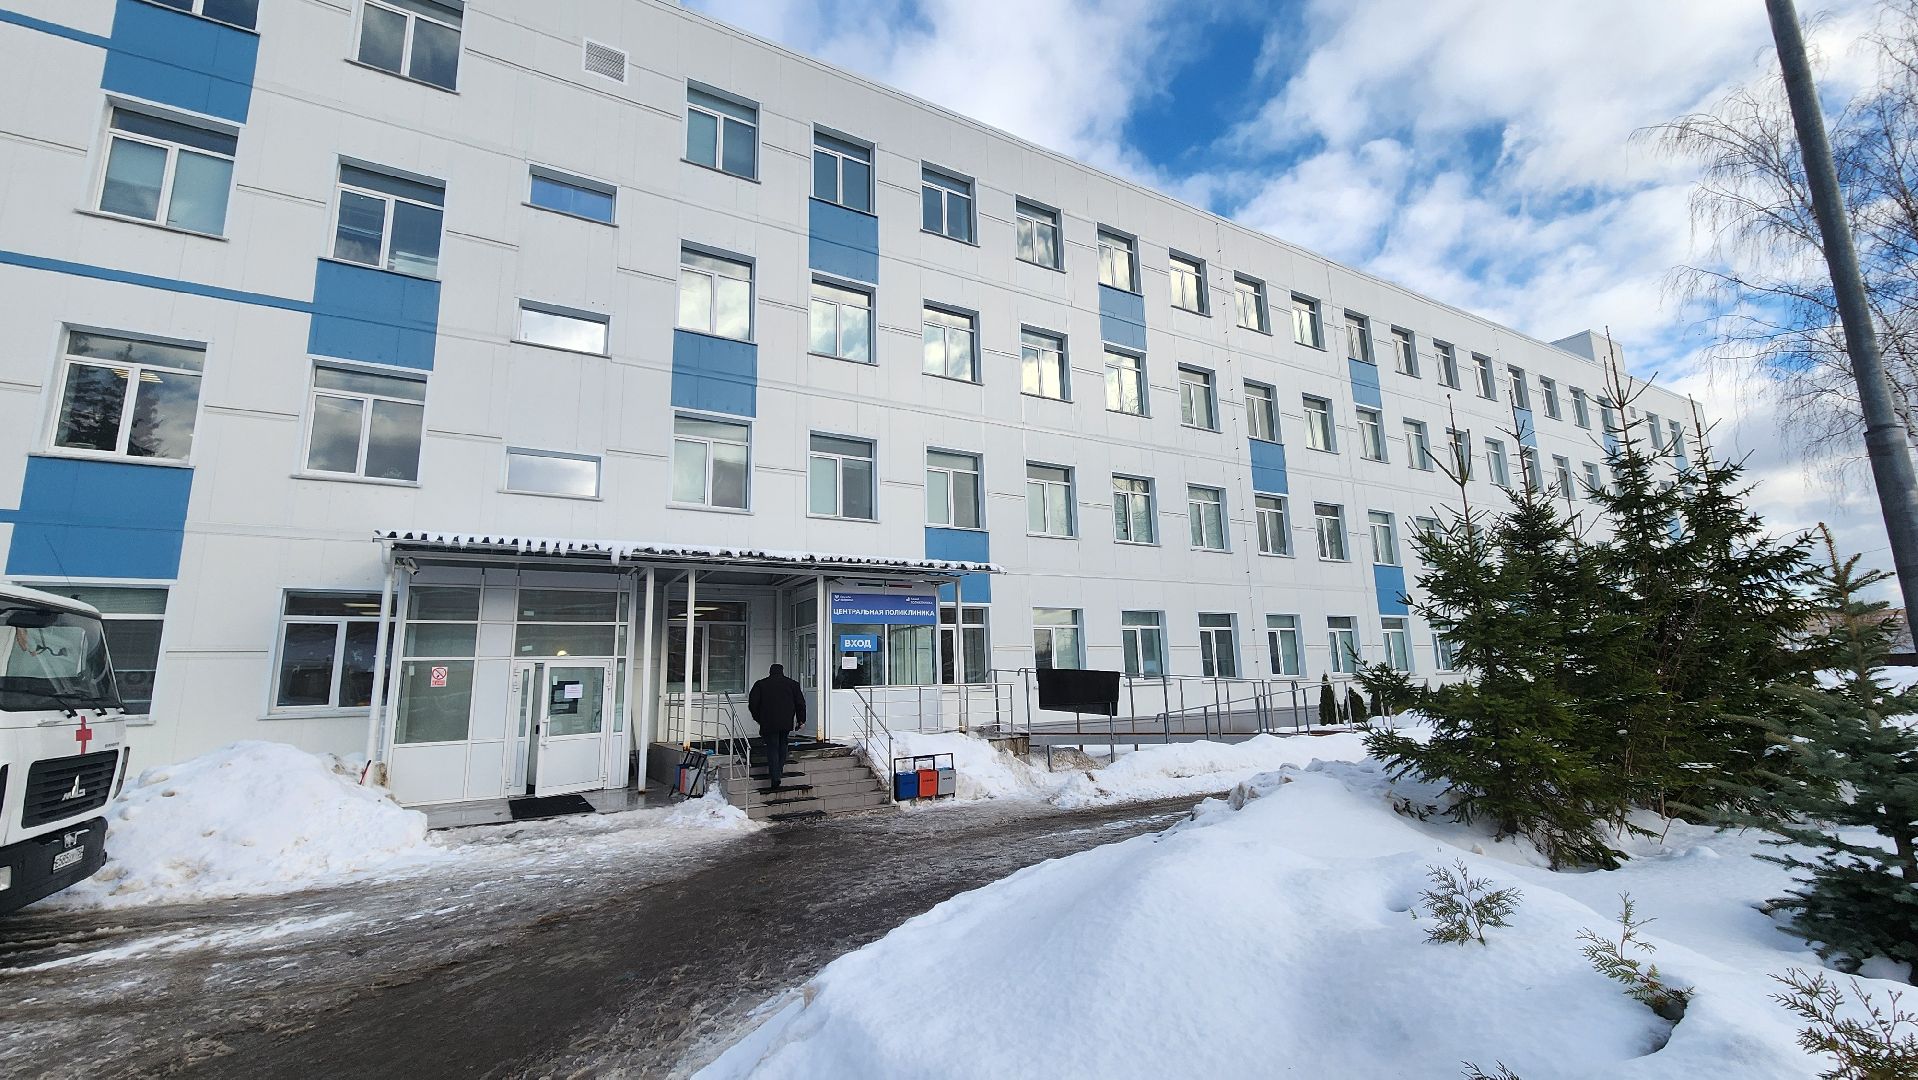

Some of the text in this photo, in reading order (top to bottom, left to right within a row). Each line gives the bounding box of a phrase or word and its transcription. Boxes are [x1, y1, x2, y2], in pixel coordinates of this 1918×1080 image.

[833, 608, 935, 617] ЦЕНТРАЛЬНАЯ ПОЛИКЛИНИКА
[844, 639, 872, 649] ВХОД
